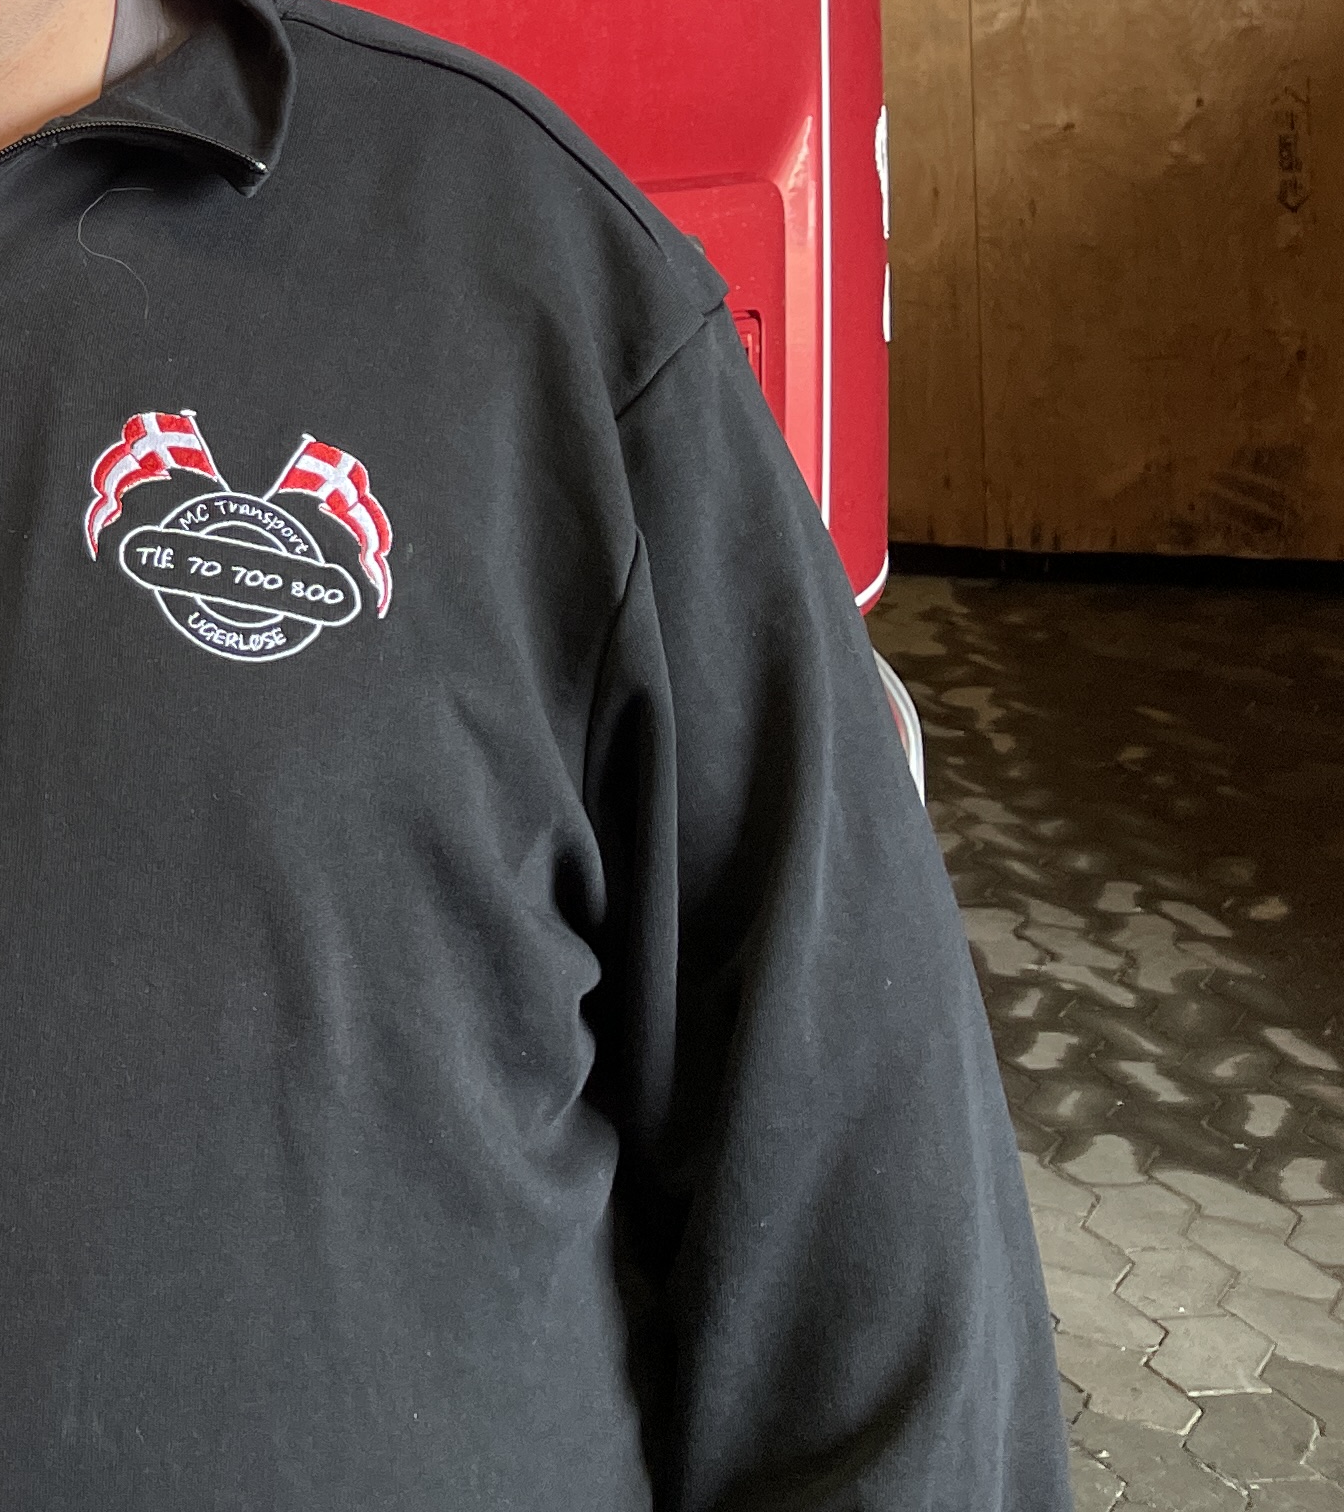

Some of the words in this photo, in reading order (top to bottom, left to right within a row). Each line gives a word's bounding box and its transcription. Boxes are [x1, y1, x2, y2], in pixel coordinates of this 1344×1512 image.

[178, 503, 210, 531] MC
[214, 499, 309, 555] Transport
[187, 556, 222, 577] 70
[231, 565, 284, 590] 700
[290, 580, 345, 605] 800
